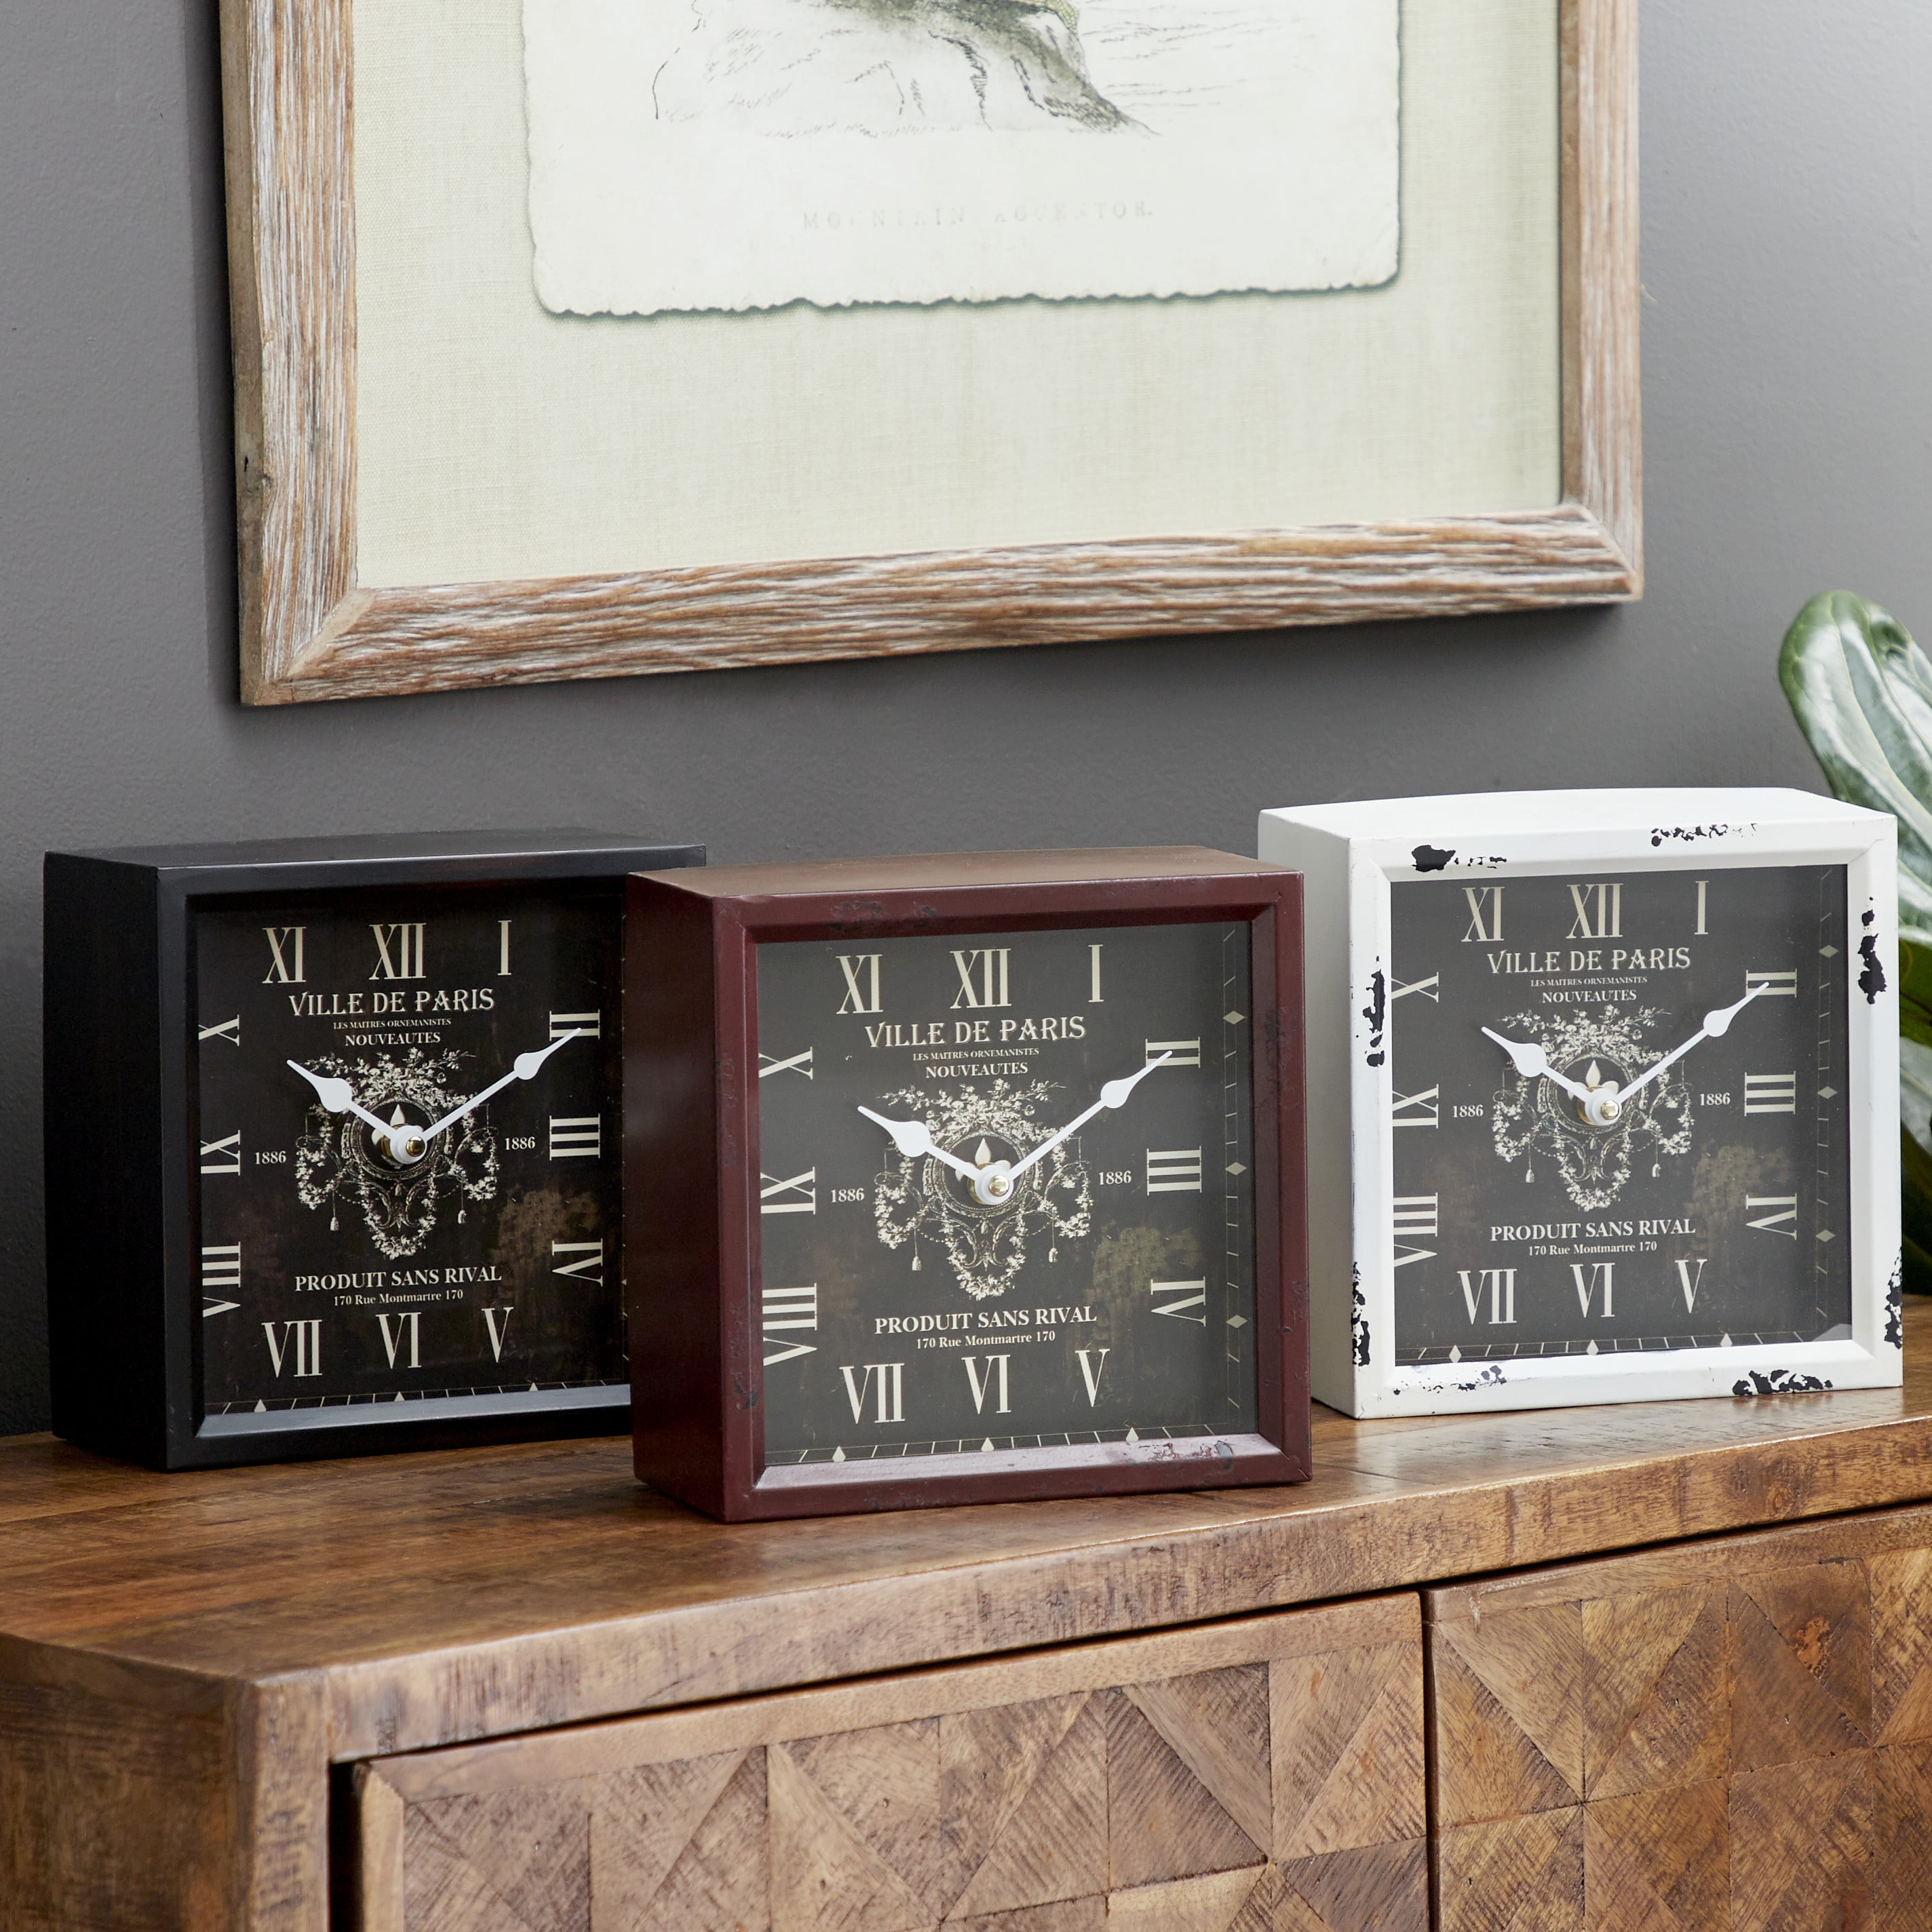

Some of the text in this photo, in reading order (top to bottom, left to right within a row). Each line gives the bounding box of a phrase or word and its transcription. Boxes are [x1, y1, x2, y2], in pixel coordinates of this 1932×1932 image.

[1461, 886, 1505, 942] XI
[1566, 883, 1623, 939] XII
[1695, 881, 1709, 935] I
[263, 927, 307, 984] XI
[369, 923, 427, 981] XII
[498, 920, 512, 976] I
[1487, 947, 1690, 973] VILLE DE PARIS
[836, 954, 883, 1014] XI
[950, 948, 1011, 1009] XII
[1088, 944, 1104, 1003] I
[1391, 971, 1439, 1003] X
[1542, 989, 1637, 1003] NOUVEAUTES
[1584, 976, 1648, 985] ORNEMANISTES
[1745, 968, 1798, 999] II
[288, 988, 495, 1016] VILLE DE PARIS
[333, 1018, 451, 1030] LES MAITRES ORNEMANISTES
[549, 1009, 600, 1041] II
[198, 1014, 239, 1046] X
[345, 1032, 441, 1046] NOUVEAUTES
[864, 1016, 1085, 1047] VILLE DE PARIS
[1145, 1037, 1201, 1068] II
[758, 1047, 813, 1079] X
[925, 1062, 1028, 1079] NOUVEAUTES
[930, 1051, 969, 1060] MAITRES
[971, 1047, 1039, 1058] ORNEMANISTES
[1392, 1083, 1439, 1129] IX
[1452, 1104, 1484, 1118] 1886
[1699, 1092, 1731, 1106] 1886
[1744, 1070, 1796, 1116] III
[200, 1129, 240, 1176] IX
[254, 1151, 286, 1165] 1886
[504, 1136, 535, 1151] 1886
[549, 1113, 601, 1161] III
[760, 1167, 815, 1215] IX
[1098, 1170, 1132, 1186] 1886
[1146, 1146, 1201, 1196] III
[831, 1189, 865, 1203] 1886
[1745, 1193, 1798, 1241] IV
[1393, 1192, 1437, 1267] VIII
[1490, 1219, 1696, 1241] PRODUIT SANS RIVAL
[1529, 1241, 1657, 1256] 170 Rue Montmartre 170
[202, 1241, 241, 1317] VIII
[294, 1266, 502, 1292] PRODUIT SANS RIVAL
[552, 1238, 604, 1287] IV
[334, 1289, 463, 1306] 170 Rue Montmartre 170
[1151, 1276, 1205, 1327] IV
[1457, 1269, 1518, 1326] VII
[1570, 1262, 1615, 1318] VI
[1675, 1259, 1707, 1313] V
[375, 1311, 422, 1370] VI
[482, 1307, 514, 1364] V
[762, 1283, 817, 1366] VIII
[874, 1306, 1097, 1334] PRODUIT SANS RIVAL
[916, 1330, 1056, 1349] 170 Rue Montmartre 170
[261, 1319, 323, 1378] VII
[840, 1363, 905, 1424] VII
[962, 1355, 1011, 1415] VI
[1075, 1349, 1110, 1408] V
